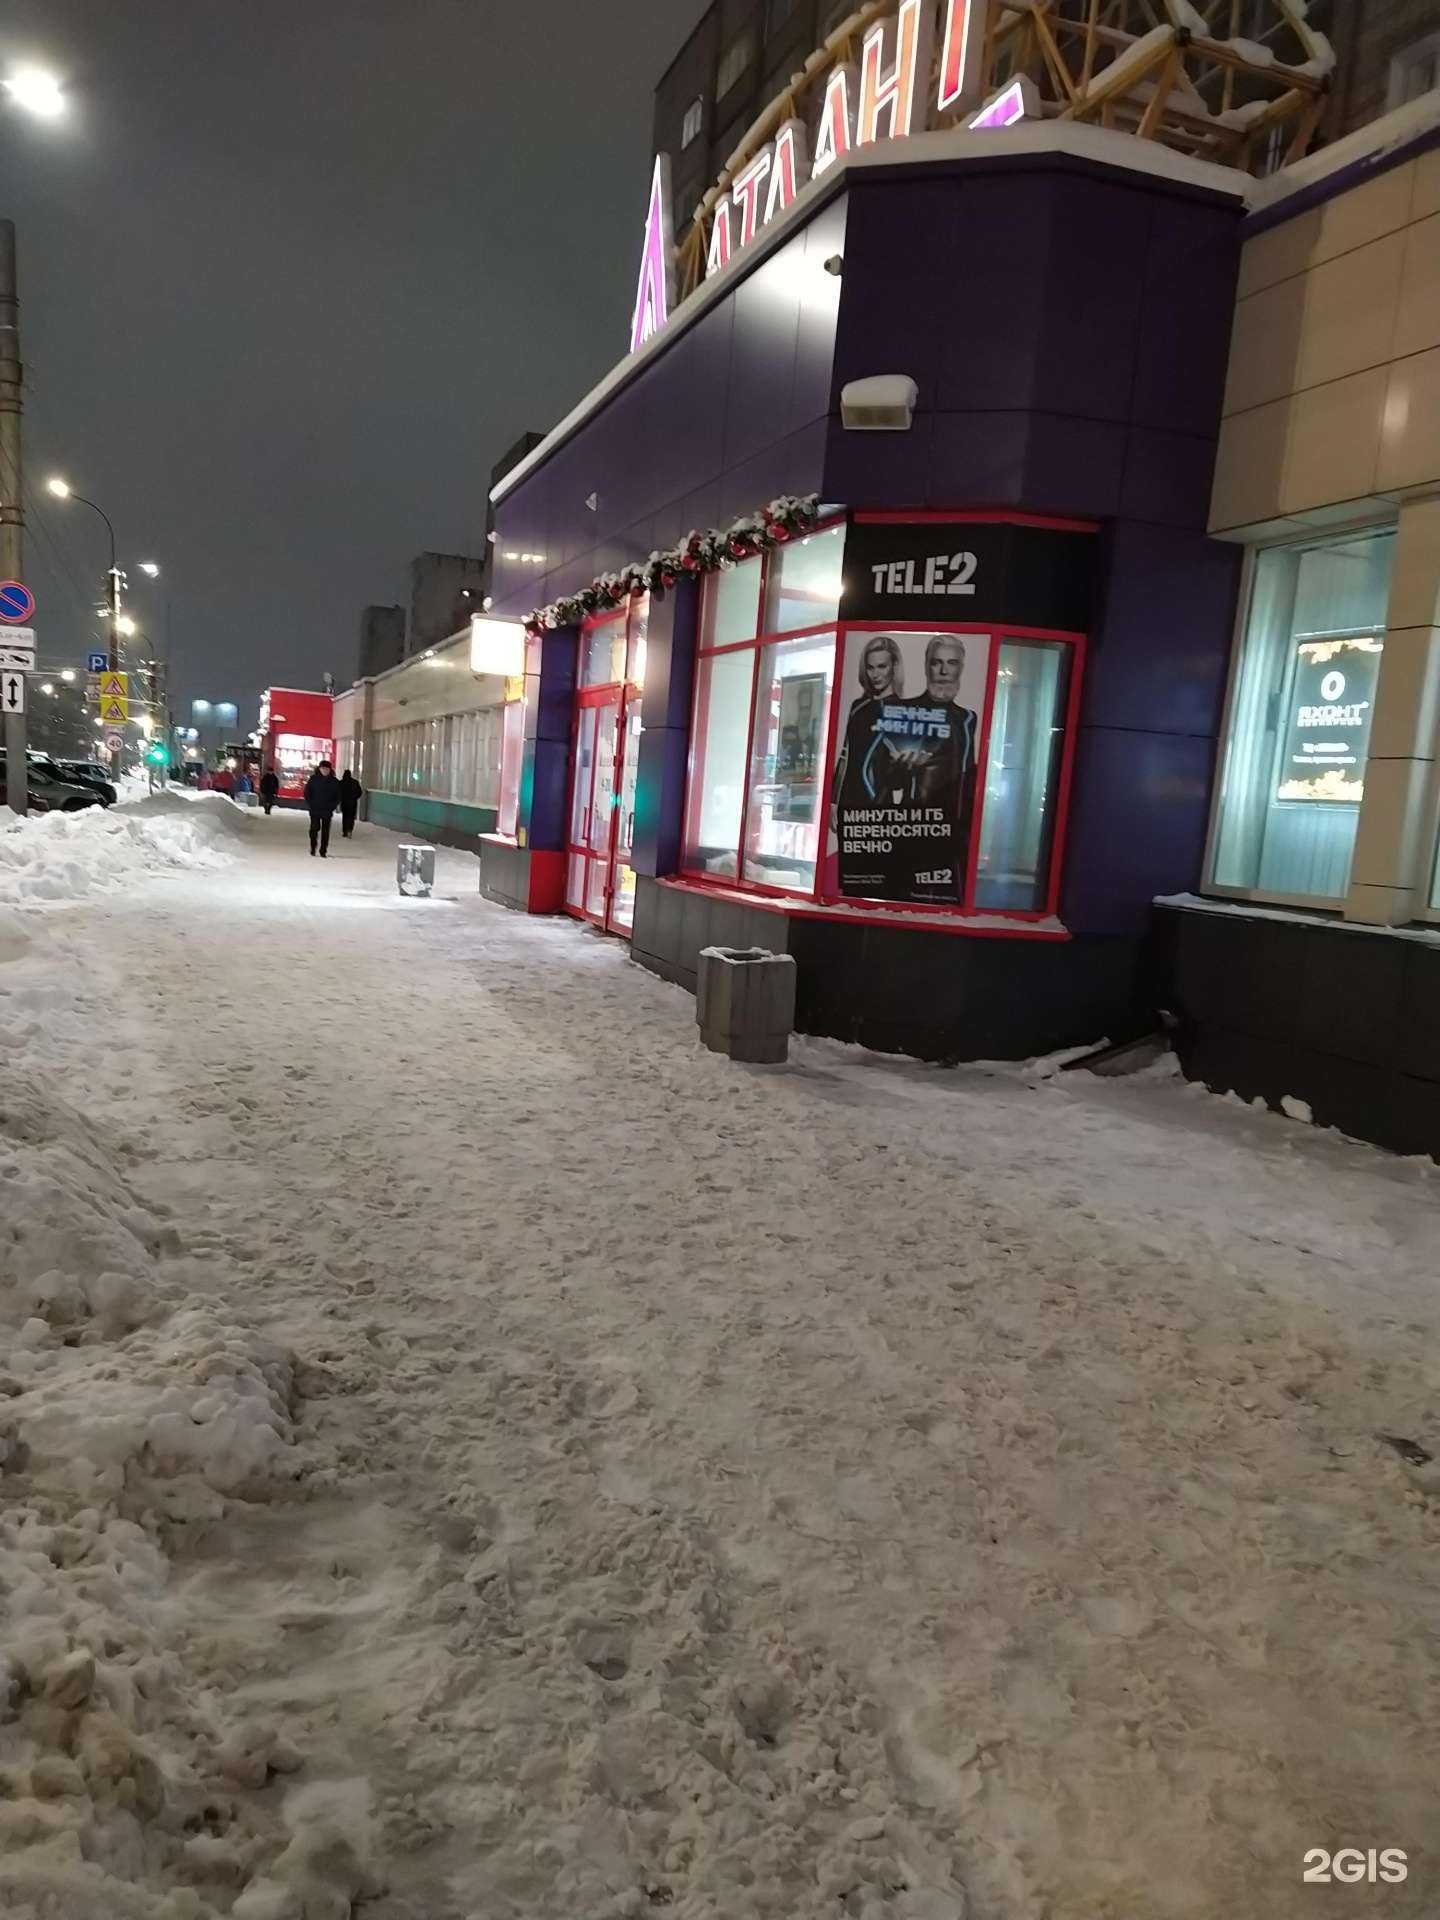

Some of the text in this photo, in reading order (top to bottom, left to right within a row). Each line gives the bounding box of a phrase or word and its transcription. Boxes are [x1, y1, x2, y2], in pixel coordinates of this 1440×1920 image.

[871, 551, 978, 595] TELE2
[911, 721, 925, 736] И
[927, 723, 951, 738] ГБ
[109, 739, 122, 747] 40
[843, 808, 944, 823] МИНУТЫ И ГБ
[843, 824, 952, 838] ПЕРЕНОСЯТСЯ
[843, 840, 893, 853] ВЕЧНО
[915, 868, 953, 884] TELE2
